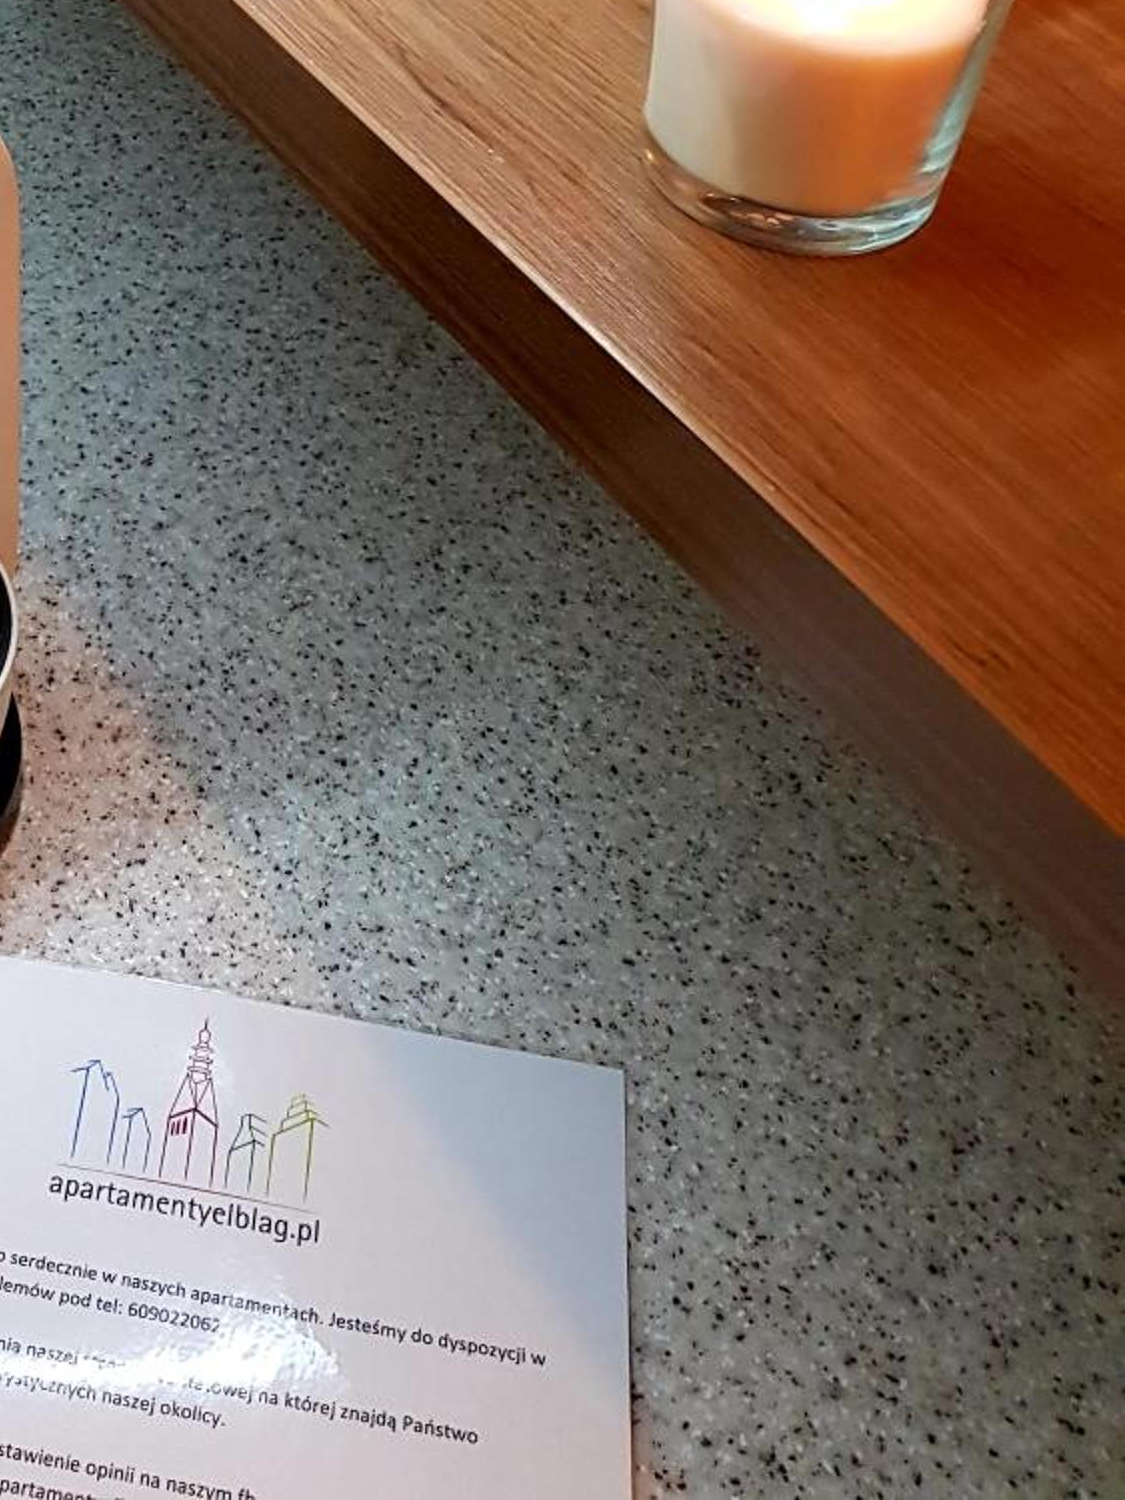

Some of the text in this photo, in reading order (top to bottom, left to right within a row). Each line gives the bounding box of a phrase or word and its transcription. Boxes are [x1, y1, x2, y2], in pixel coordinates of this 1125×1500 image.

[48, 1173, 321, 1247] apartamentyelblag.pl
[9, 1249, 98, 1282] serdecznie
[101, 1269, 119, 1286] w
[121, 1272, 186, 1301] naszych
[189, 1286, 325, 1327] apartamentach.
[328, 1312, 408, 1345] Jesteśmy
[410, 1327, 434, 1347] do
[437, 1332, 527, 1365] dyspozycji
[529, 1350, 547, 1368] w
[59, 1289, 92, 1310] pod
[95, 1297, 124, 1316] tel:
[101, 1389, 157, 1417] naszej
[160, 1400, 228, 1429] okolicy.
[257, 1389, 279, 1406] na
[282, 1393, 337, 1421] której
[339, 1404, 398, 1433] znajdą
[401, 1414, 480, 1446] Państwo
[85, 1461, 136, 1483] opinii
[140, 1473, 161, 1490] na
